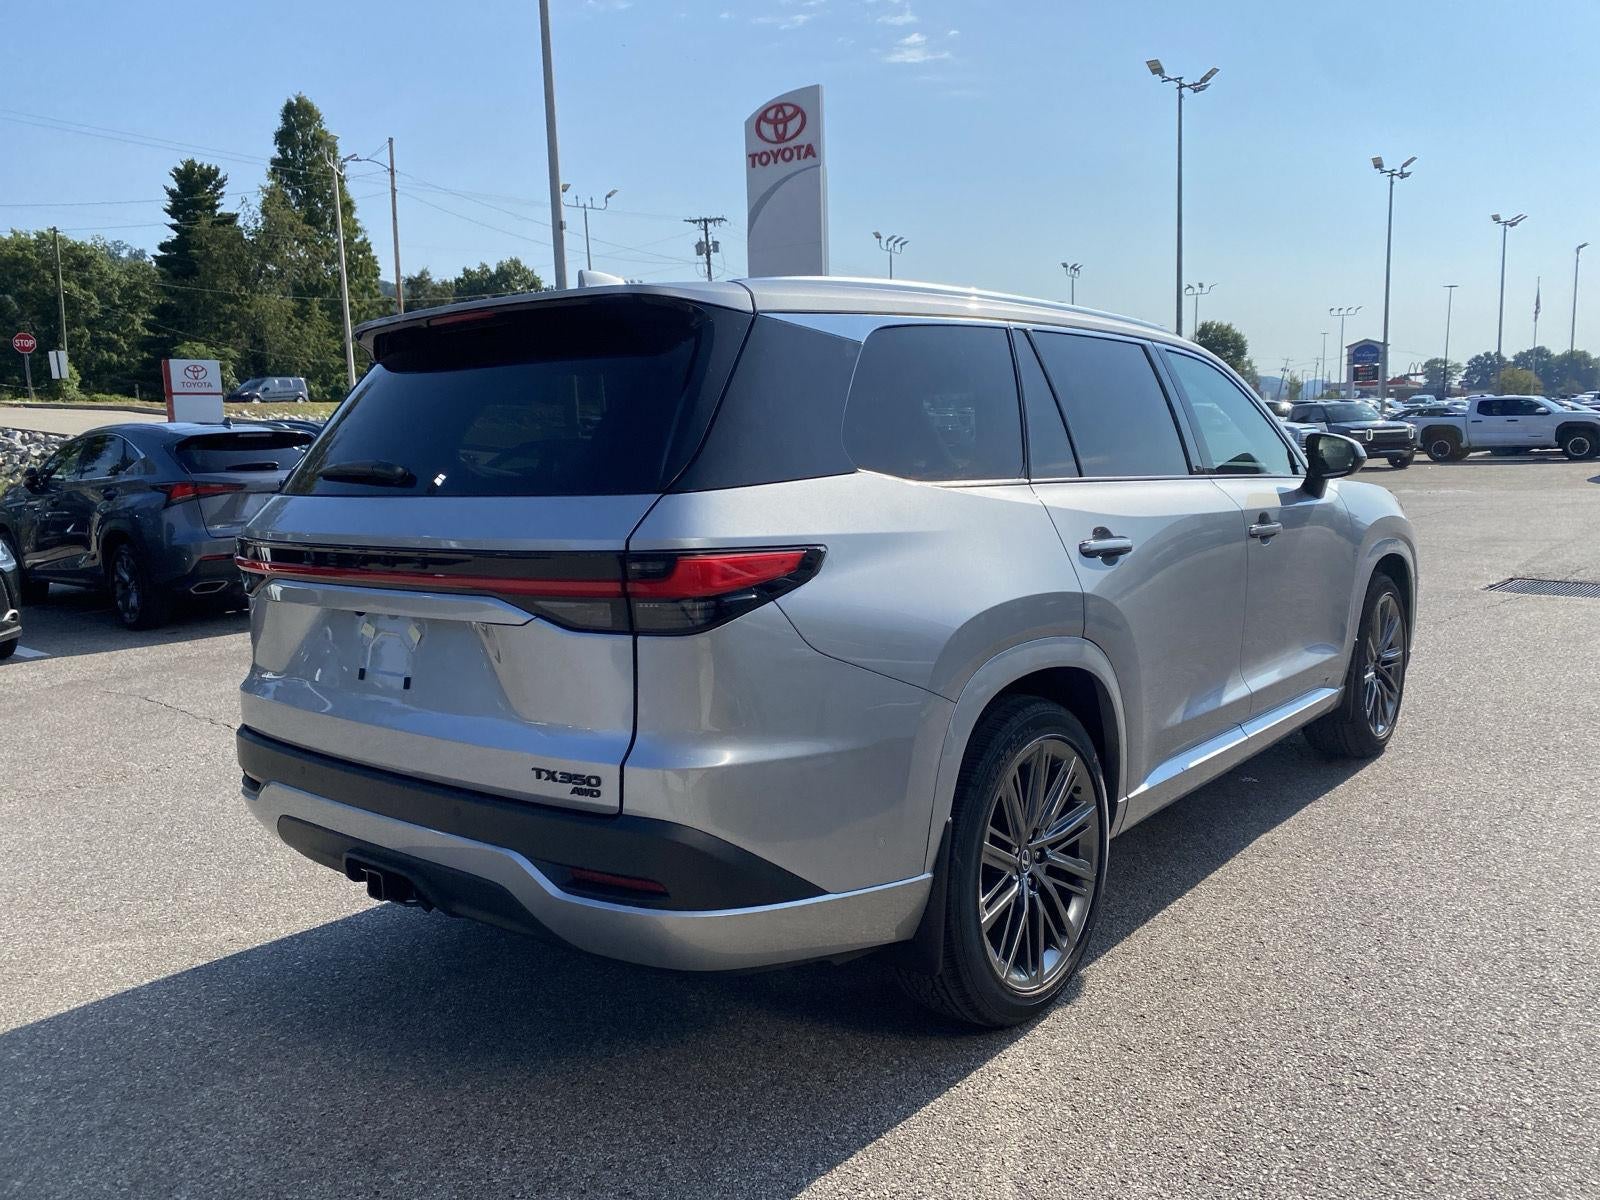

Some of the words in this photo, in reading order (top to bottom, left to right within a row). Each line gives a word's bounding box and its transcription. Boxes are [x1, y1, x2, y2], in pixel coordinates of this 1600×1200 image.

[748, 143, 816, 168] TOYOTA
[15, 339, 34, 348] STOP
[181, 381, 213, 389] TOYOTA
[531, 767, 602, 787] TX350
[570, 786, 602, 798] AWD
